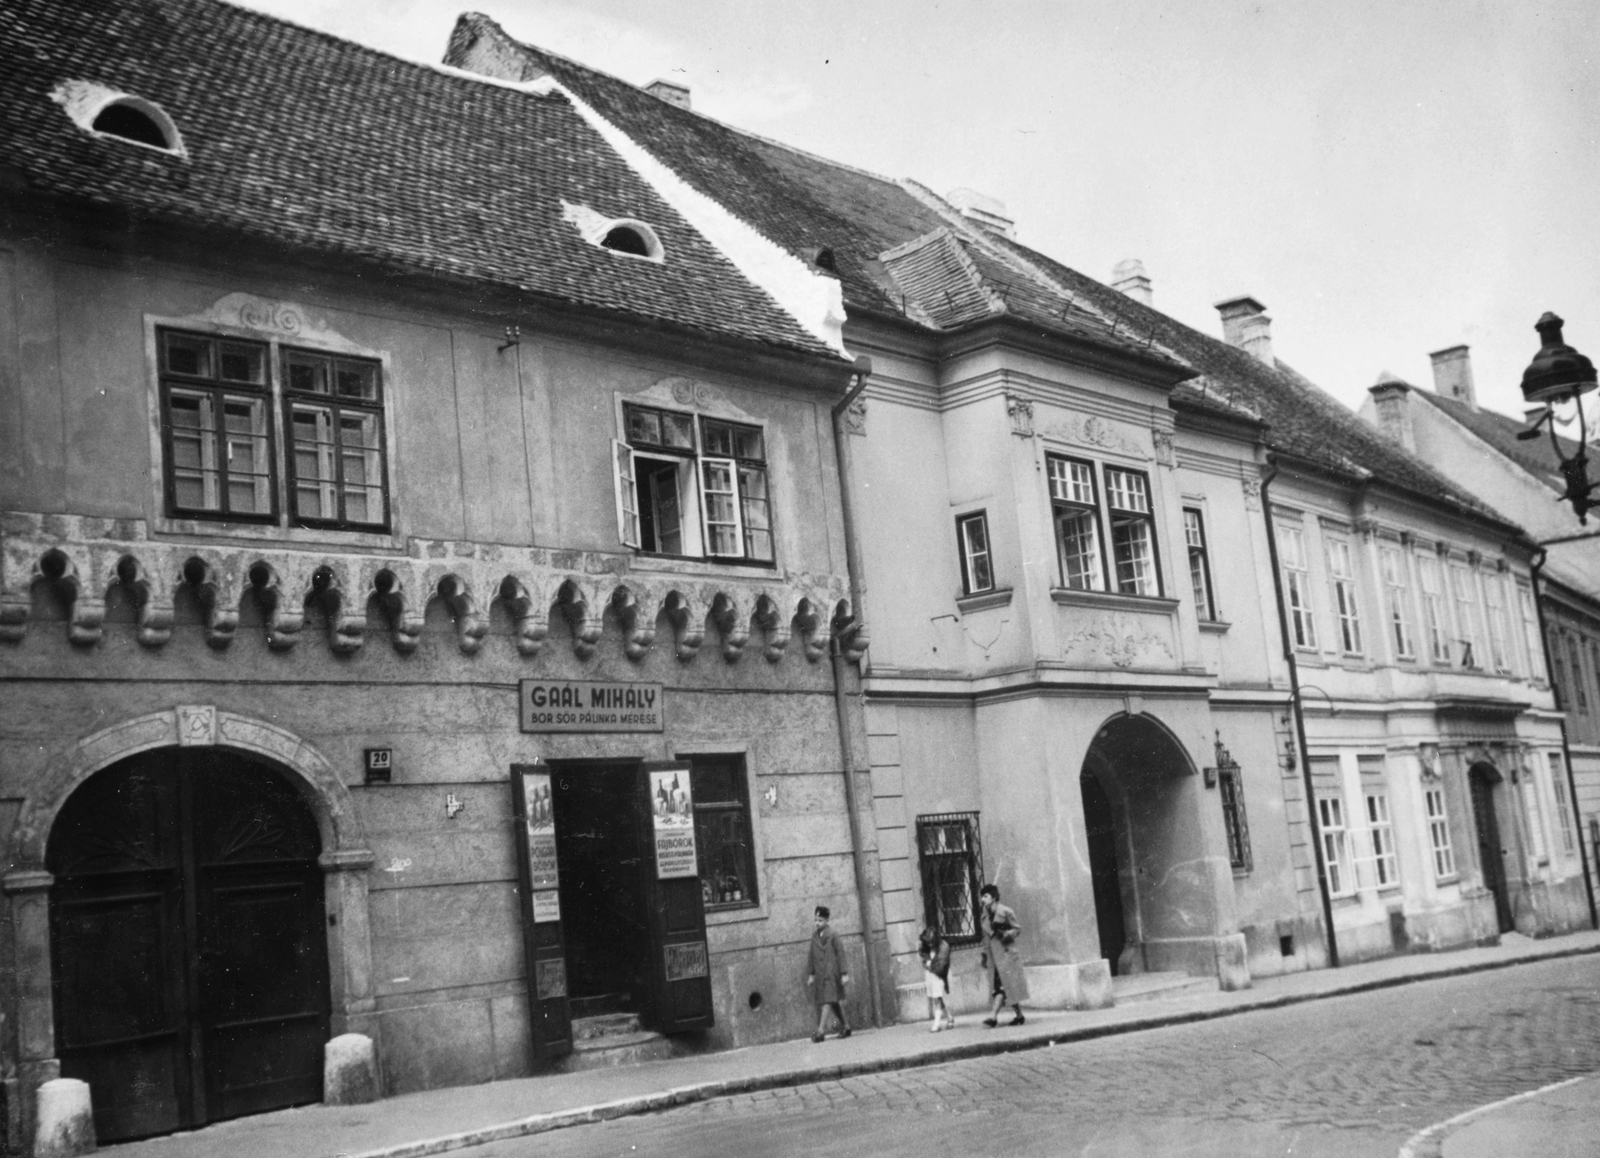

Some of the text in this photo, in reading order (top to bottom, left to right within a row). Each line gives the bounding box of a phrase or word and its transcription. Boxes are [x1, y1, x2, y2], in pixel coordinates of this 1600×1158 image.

[531, 682, 655, 709] GAÁL MIHÁLY
[531, 712, 553, 724] BOR
[579, 710, 617, 724] PÁLINKA
[373, 751, 388, 763] 20
